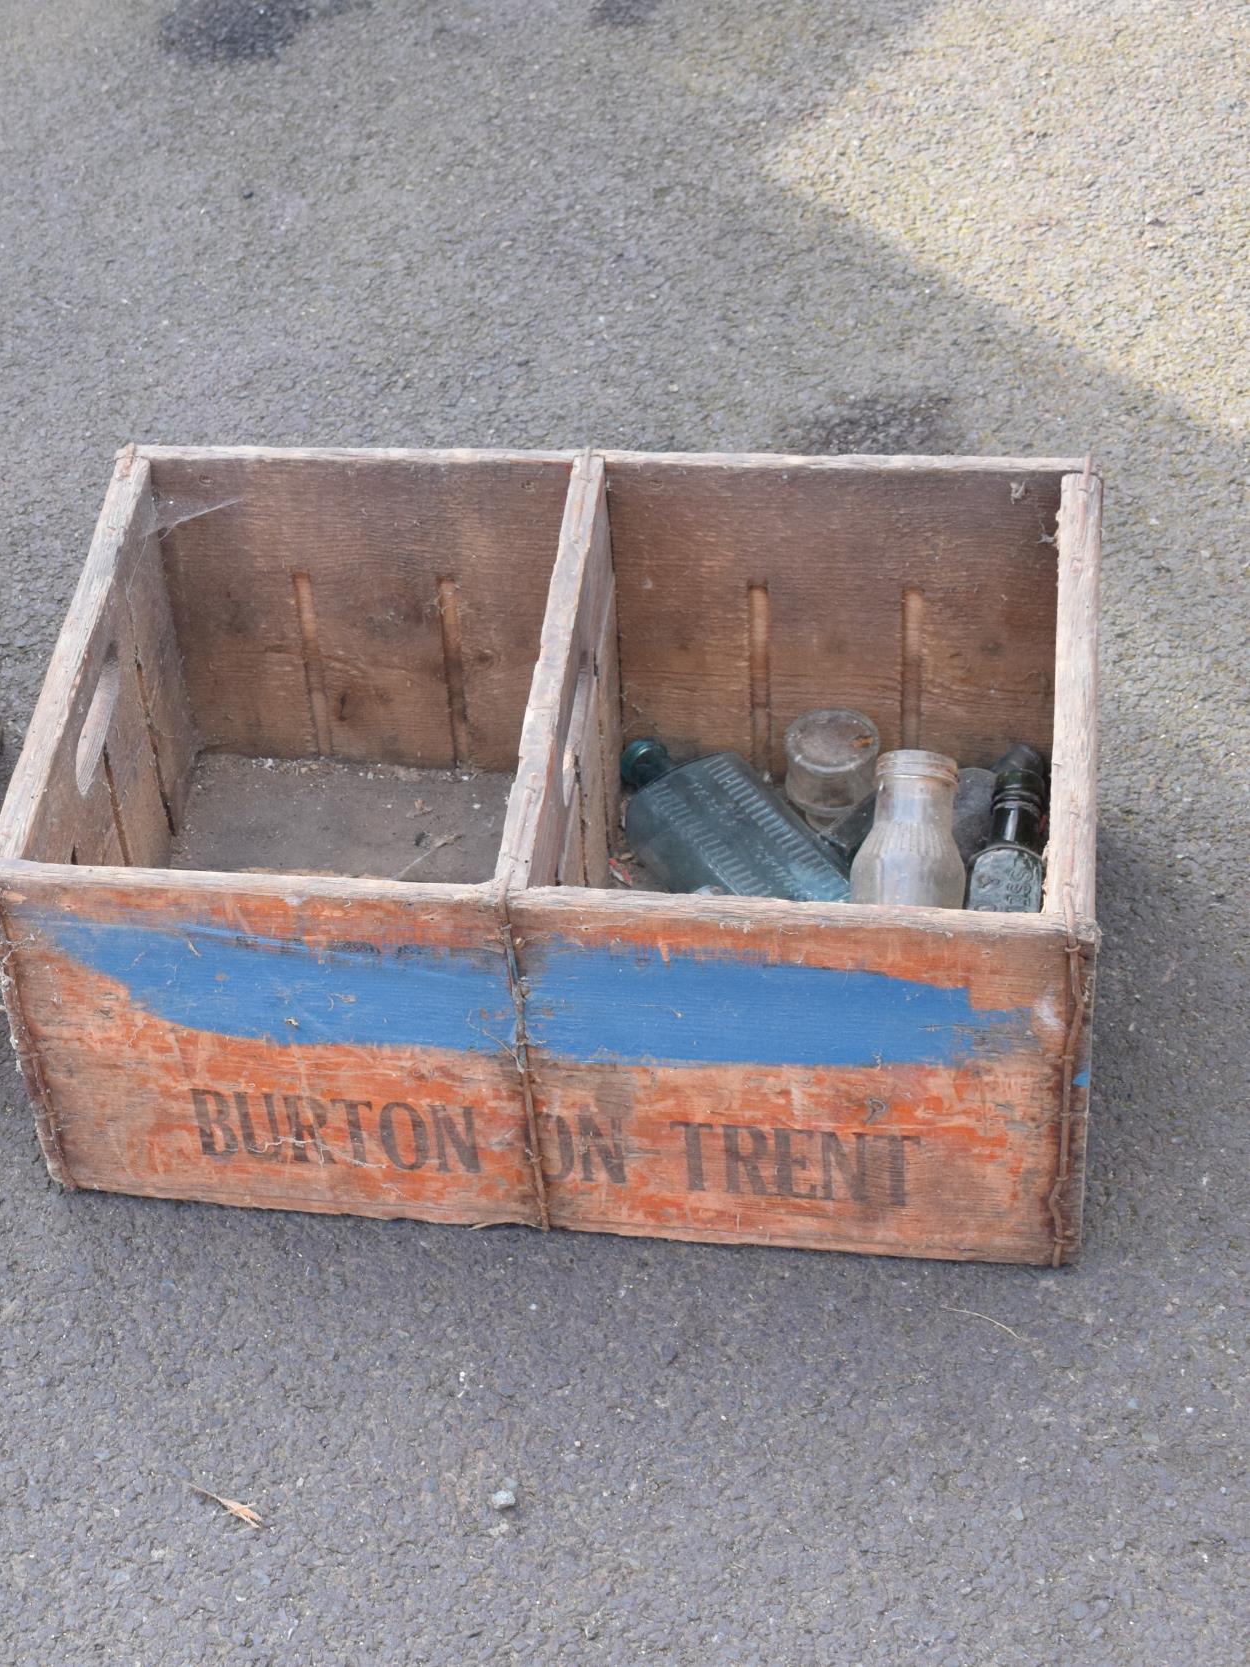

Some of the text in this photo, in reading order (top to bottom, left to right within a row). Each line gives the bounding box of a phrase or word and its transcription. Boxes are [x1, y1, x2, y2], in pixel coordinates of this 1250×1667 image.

[189, 1088, 921, 1206] BURTON ON TRENT
